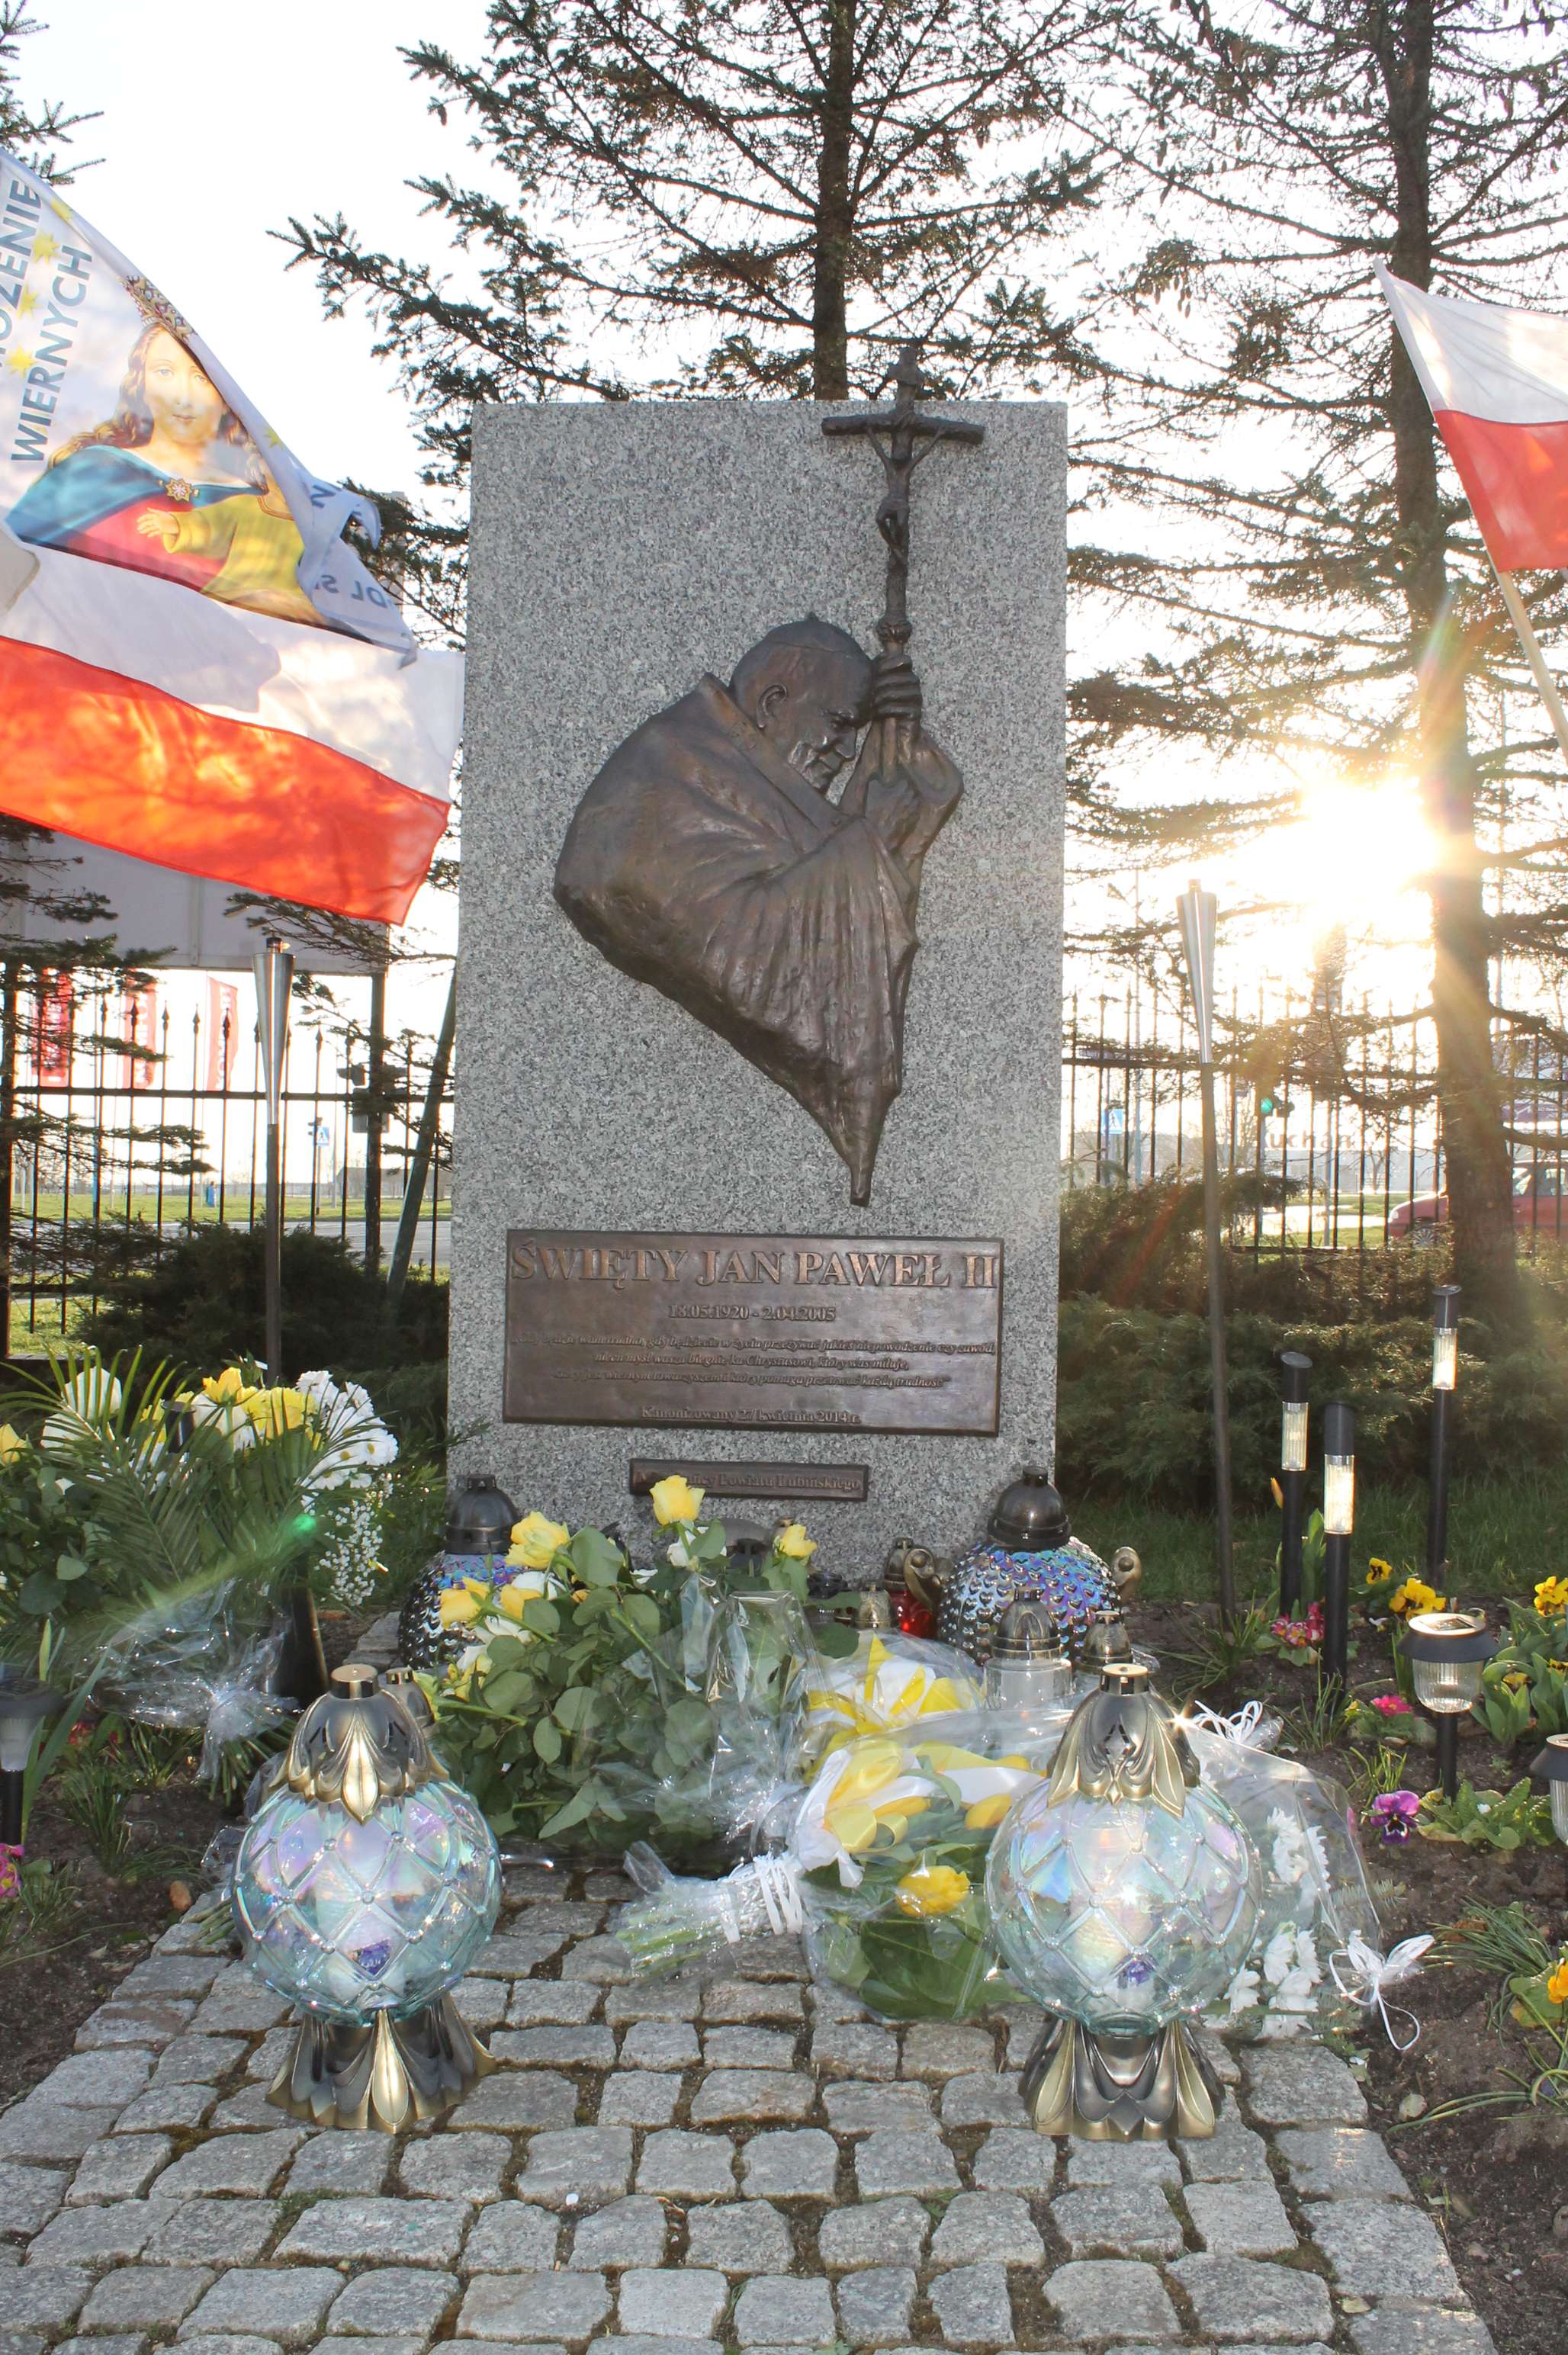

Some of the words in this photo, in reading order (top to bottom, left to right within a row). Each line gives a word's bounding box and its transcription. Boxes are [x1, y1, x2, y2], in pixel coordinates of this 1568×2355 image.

[11, 244, 93, 461] WIERNYCH
[512, 1239, 689, 1290] ŚWIĘTY
[696, 1248, 785, 1287] JAN
[795, 1251, 951, 1287] PAWEŁ
[962, 1254, 997, 1288] II
[670, 1304, 750, 1320] 18.05.1920
[762, 1306, 837, 1322] 2.04.2005
[937, 1344, 955, 1355] czy
[641, 1406, 735, 1427] Kanonizowany
[759, 1409, 815, 1425] kwietnia
[818, 1412, 847, 1427] 2014
[850, 1415, 861, 1428] r.
